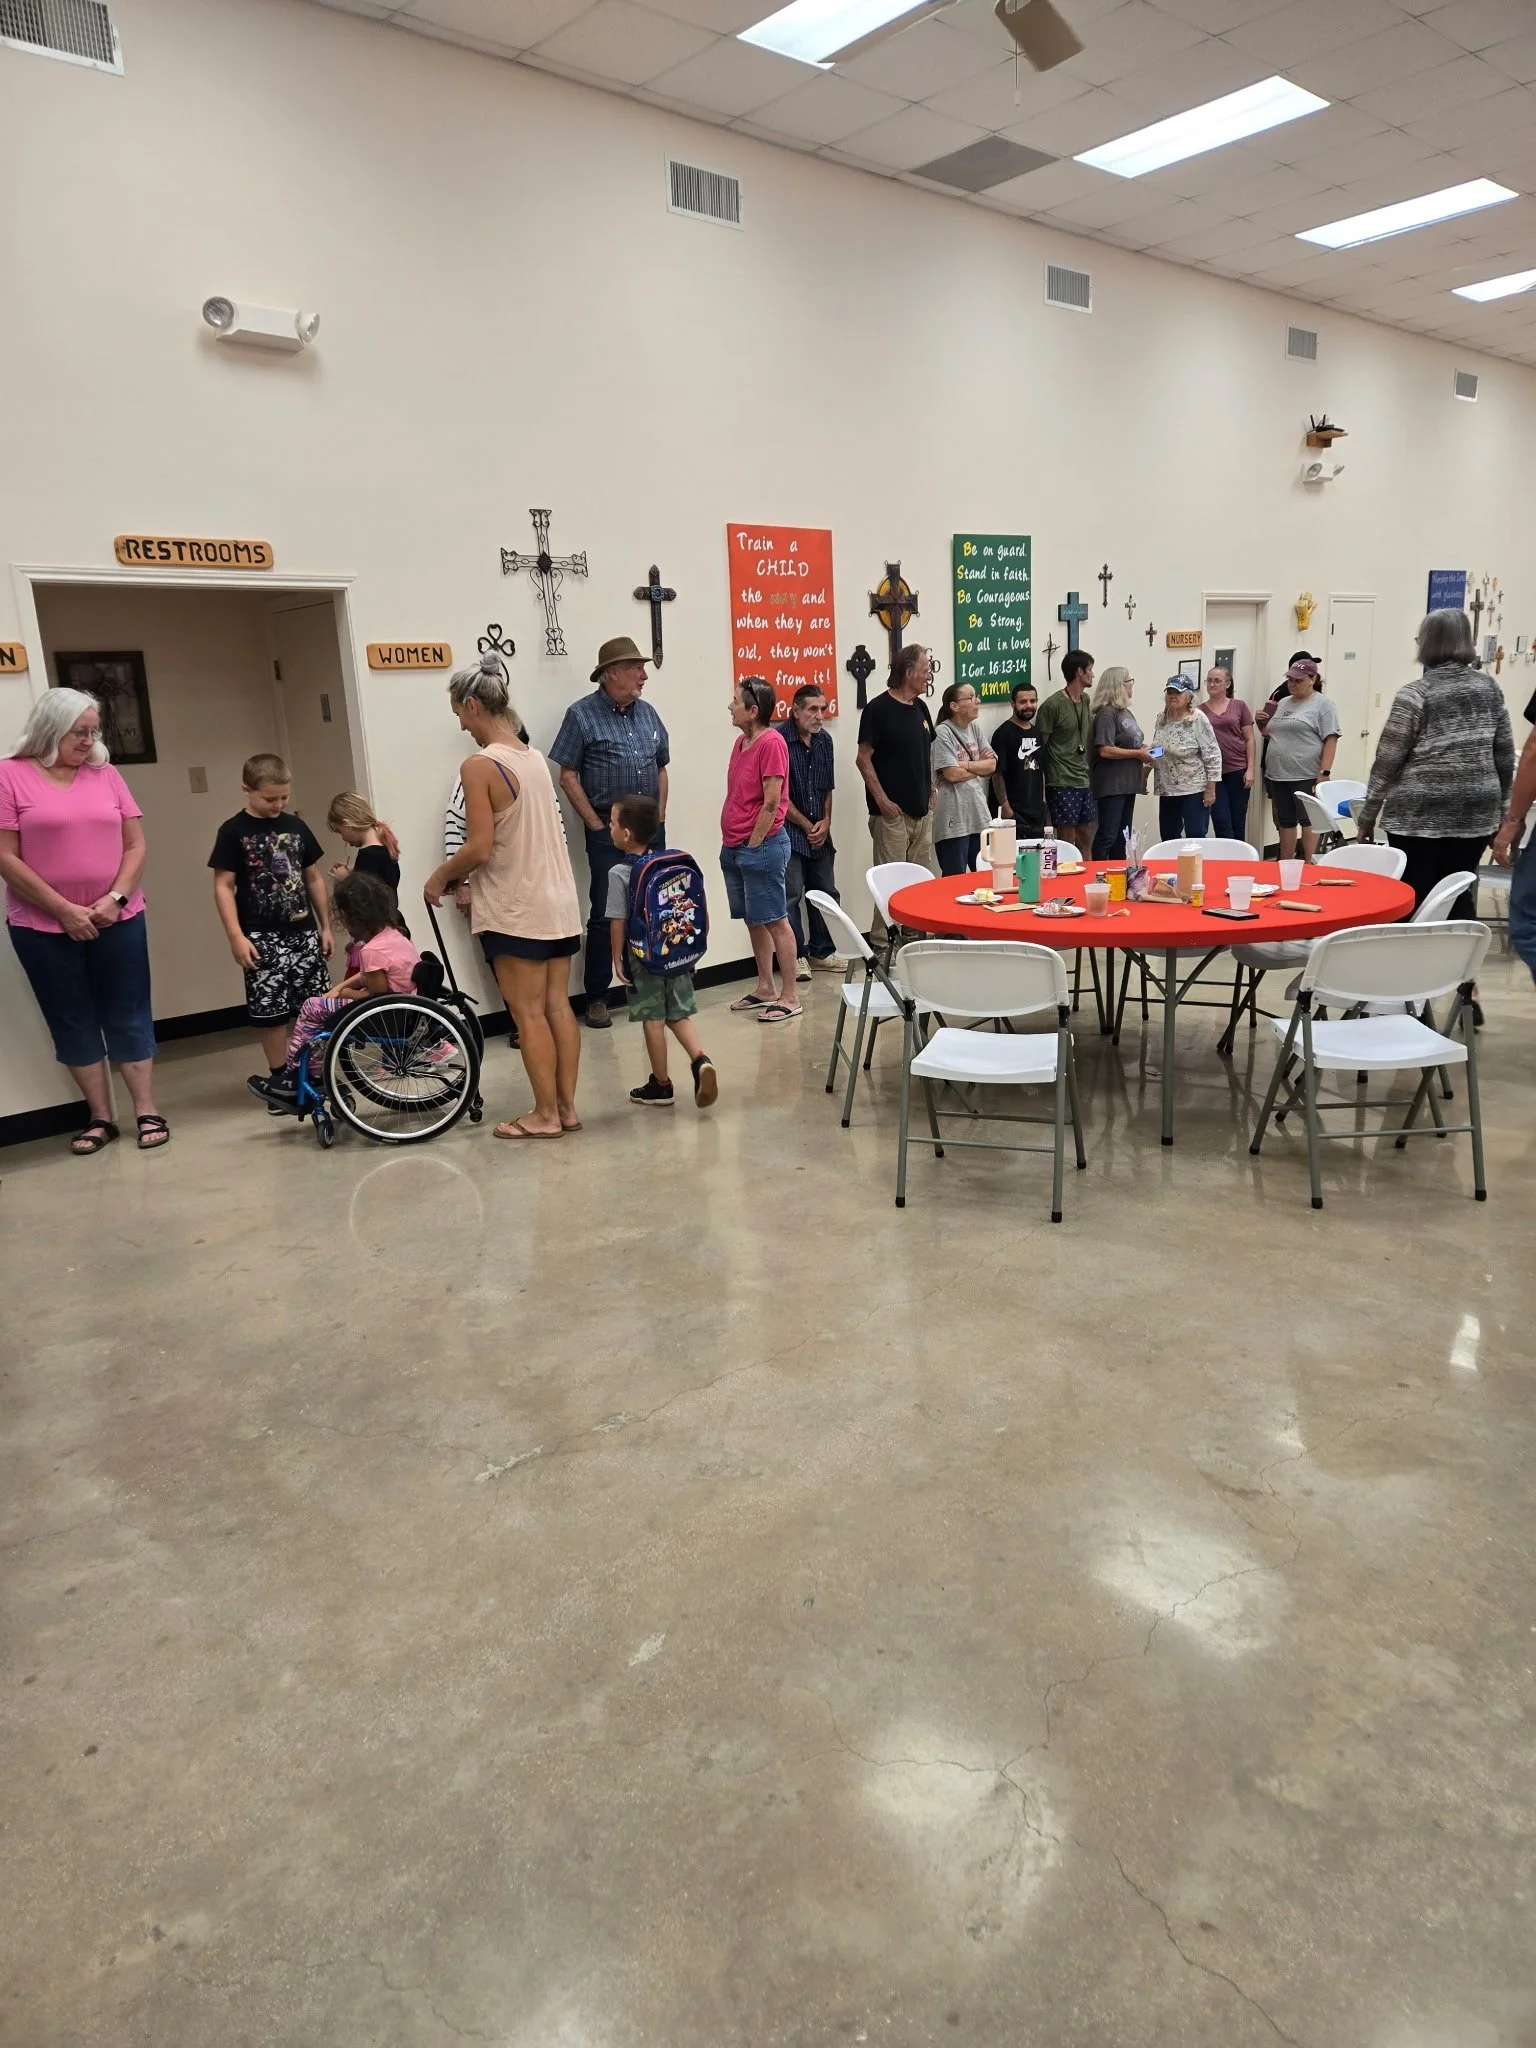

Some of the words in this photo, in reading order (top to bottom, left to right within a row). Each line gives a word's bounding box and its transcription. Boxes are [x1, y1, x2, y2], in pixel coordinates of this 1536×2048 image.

[737, 531, 774, 551] Train
[790, 540, 798, 552] a
[963, 541, 977, 557] Be
[983, 546, 994, 556] on
[126, 538, 266, 564] RESTROOMS
[757, 559, 809, 577] CHILD
[957, 565, 986, 580] Stand
[991, 568, 1000, 580] in
[742, 589, 762, 603] the
[802, 588, 826, 605] and
[957, 589, 972, 604] Be
[737, 612, 769, 630] when
[775, 612, 802, 635] they
[810, 617, 831, 630] are
[969, 614, 983, 628] Be
[958, 638, 973, 653] Do
[977, 637, 990, 651] all
[998, 641, 1008, 651] in
[1171, 633, 1201, 645] NURSERY
[379, 647, 444, 664] WOMEN
[738, 642, 762, 661] old,
[770, 642, 799, 662] they
[804, 643, 833, 658] won't
[776, 669, 807, 686] from
[814, 668, 831, 685] it!
[962, 664, 967, 677] 1
[969, 663, 985, 678] Cor.
[989, 659, 1027, 676] 16:13-14
[1043, 850, 1051, 870] hint
